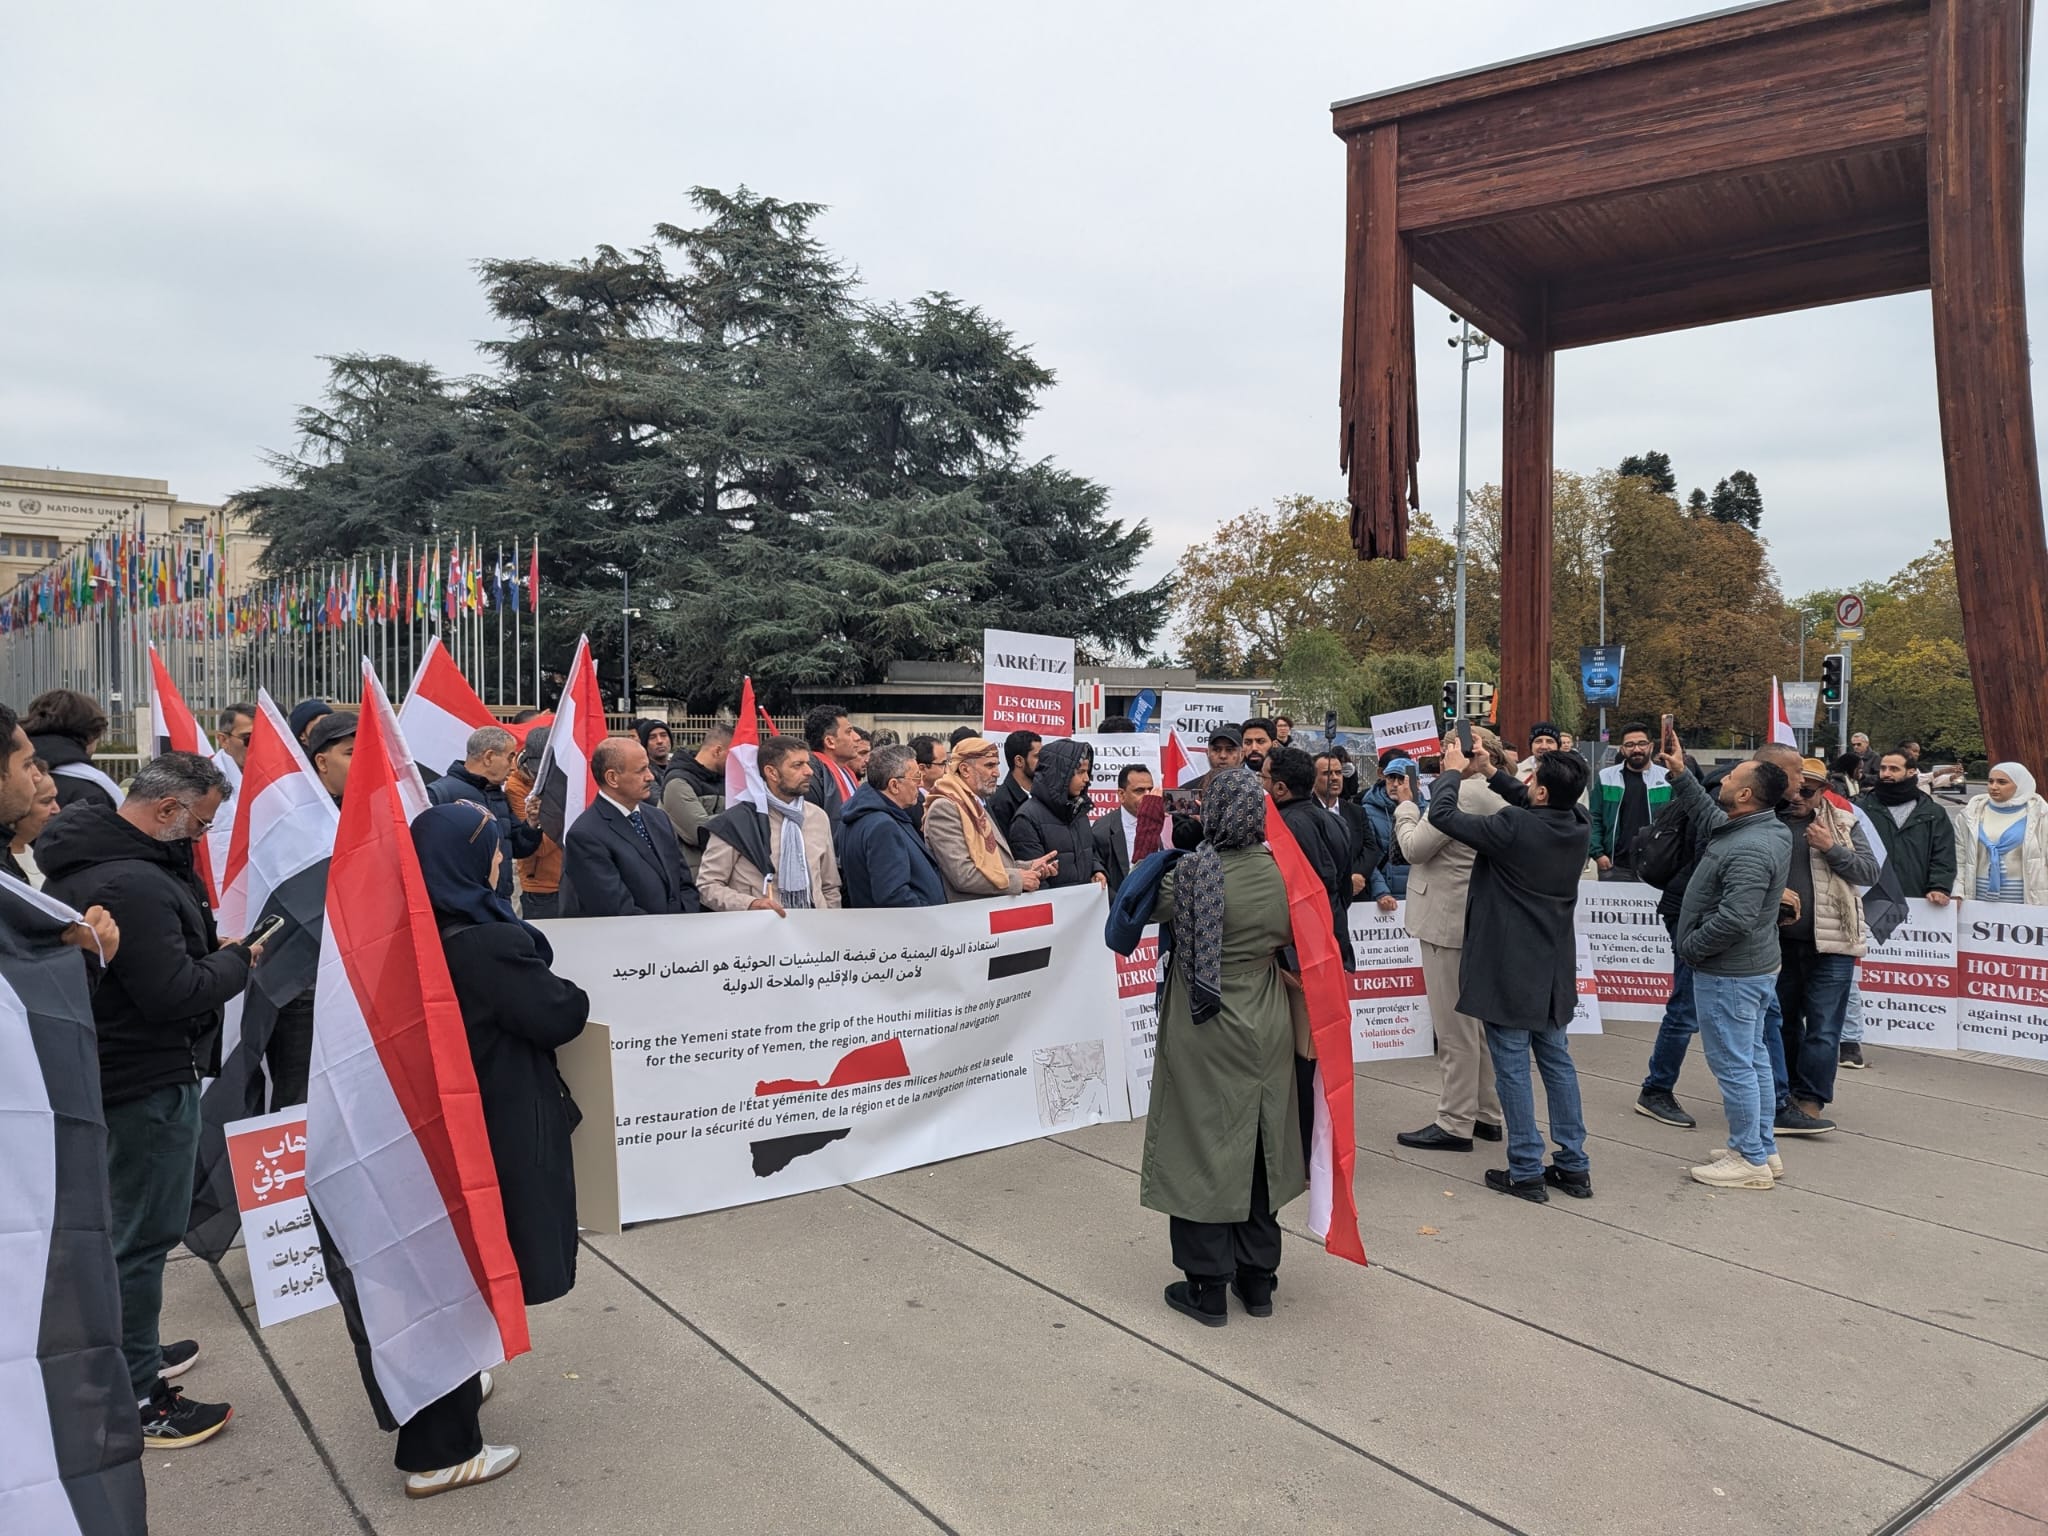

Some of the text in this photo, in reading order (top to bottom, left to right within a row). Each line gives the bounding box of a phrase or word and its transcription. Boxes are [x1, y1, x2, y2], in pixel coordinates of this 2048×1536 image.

[46, 504, 94, 514] NATIONS
[993, 653, 1067, 674] ARRÊTEZ
[998, 695, 1061, 711] LES CRIMES
[1185, 704, 1224, 713] LIFT THE
[993, 710, 1065, 726] DES HOUTHIS
[1380, 720, 1432, 737] ARRÊTEZ
[1095, 746, 1140, 757] LENCE
[1407, 744, 1433, 756] RIMES
[1585, 897, 1660, 908] LE TERRORIS
[1374, 915, 1395, 923] NOUS
[1350, 927, 1413, 942] APPELON
[1588, 932, 1618, 941] enace
[1620, 932, 1629, 941] la
[1867, 930, 1953, 945] LATION
[1360, 944, 1409, 954] à une action
[1641, 944, 1654, 953] de
[1656, 945, 1665, 954] la
[1905, 949, 1950, 960] militias
[612, 937, 1000, 981] استعادة الدولة اليمنية من قبضة المليشيات الحوثية هو الضمان الوحيد
[1357, 955, 1414, 967] internationale
[1597, 955, 1655, 964] région et de
[1117, 967, 1157, 987] TERRO
[1967, 959, 2048, 981] HOUTH
[722, 965, 922, 995] لأمن اليمن والإقليم والملاحة الدولية
[1354, 975, 1414, 991] URGENTE
[1601, 975, 1669, 986] NAVIGATION
[1861, 968, 1950, 989] ESTROYS
[1597, 986, 1673, 998] ERNATIONALE
[1967, 980, 2048, 1003] CRIMES
[1356, 1002, 1420, 1016] pour protéger le
[1878, 998, 1947, 1014] chances
[611, 989, 1032, 1050] toring the Yemeni state from the grip of the Houthi militias is the only guarantee
[1365, 1014, 1409, 1026] Yémen des
[1863, 1013, 1935, 1031] or peace
[1967, 1008, 2022, 1023] against
[646, 1013, 1000, 1067] for the security of Yemen, the region, and international navigation
[1359, 1026, 1416, 1039] violations des
[1957, 1021, 2048, 1044] emeni peop
[1372, 1040, 1405, 1050] Houthis
[616, 1052, 1014, 1127] La restauration de l'État yéménite des mains des milices houthis est la seule
[617, 1066, 1028, 1147] antie pour la sécurité du Yémen, de la région et de la navigation internationale
